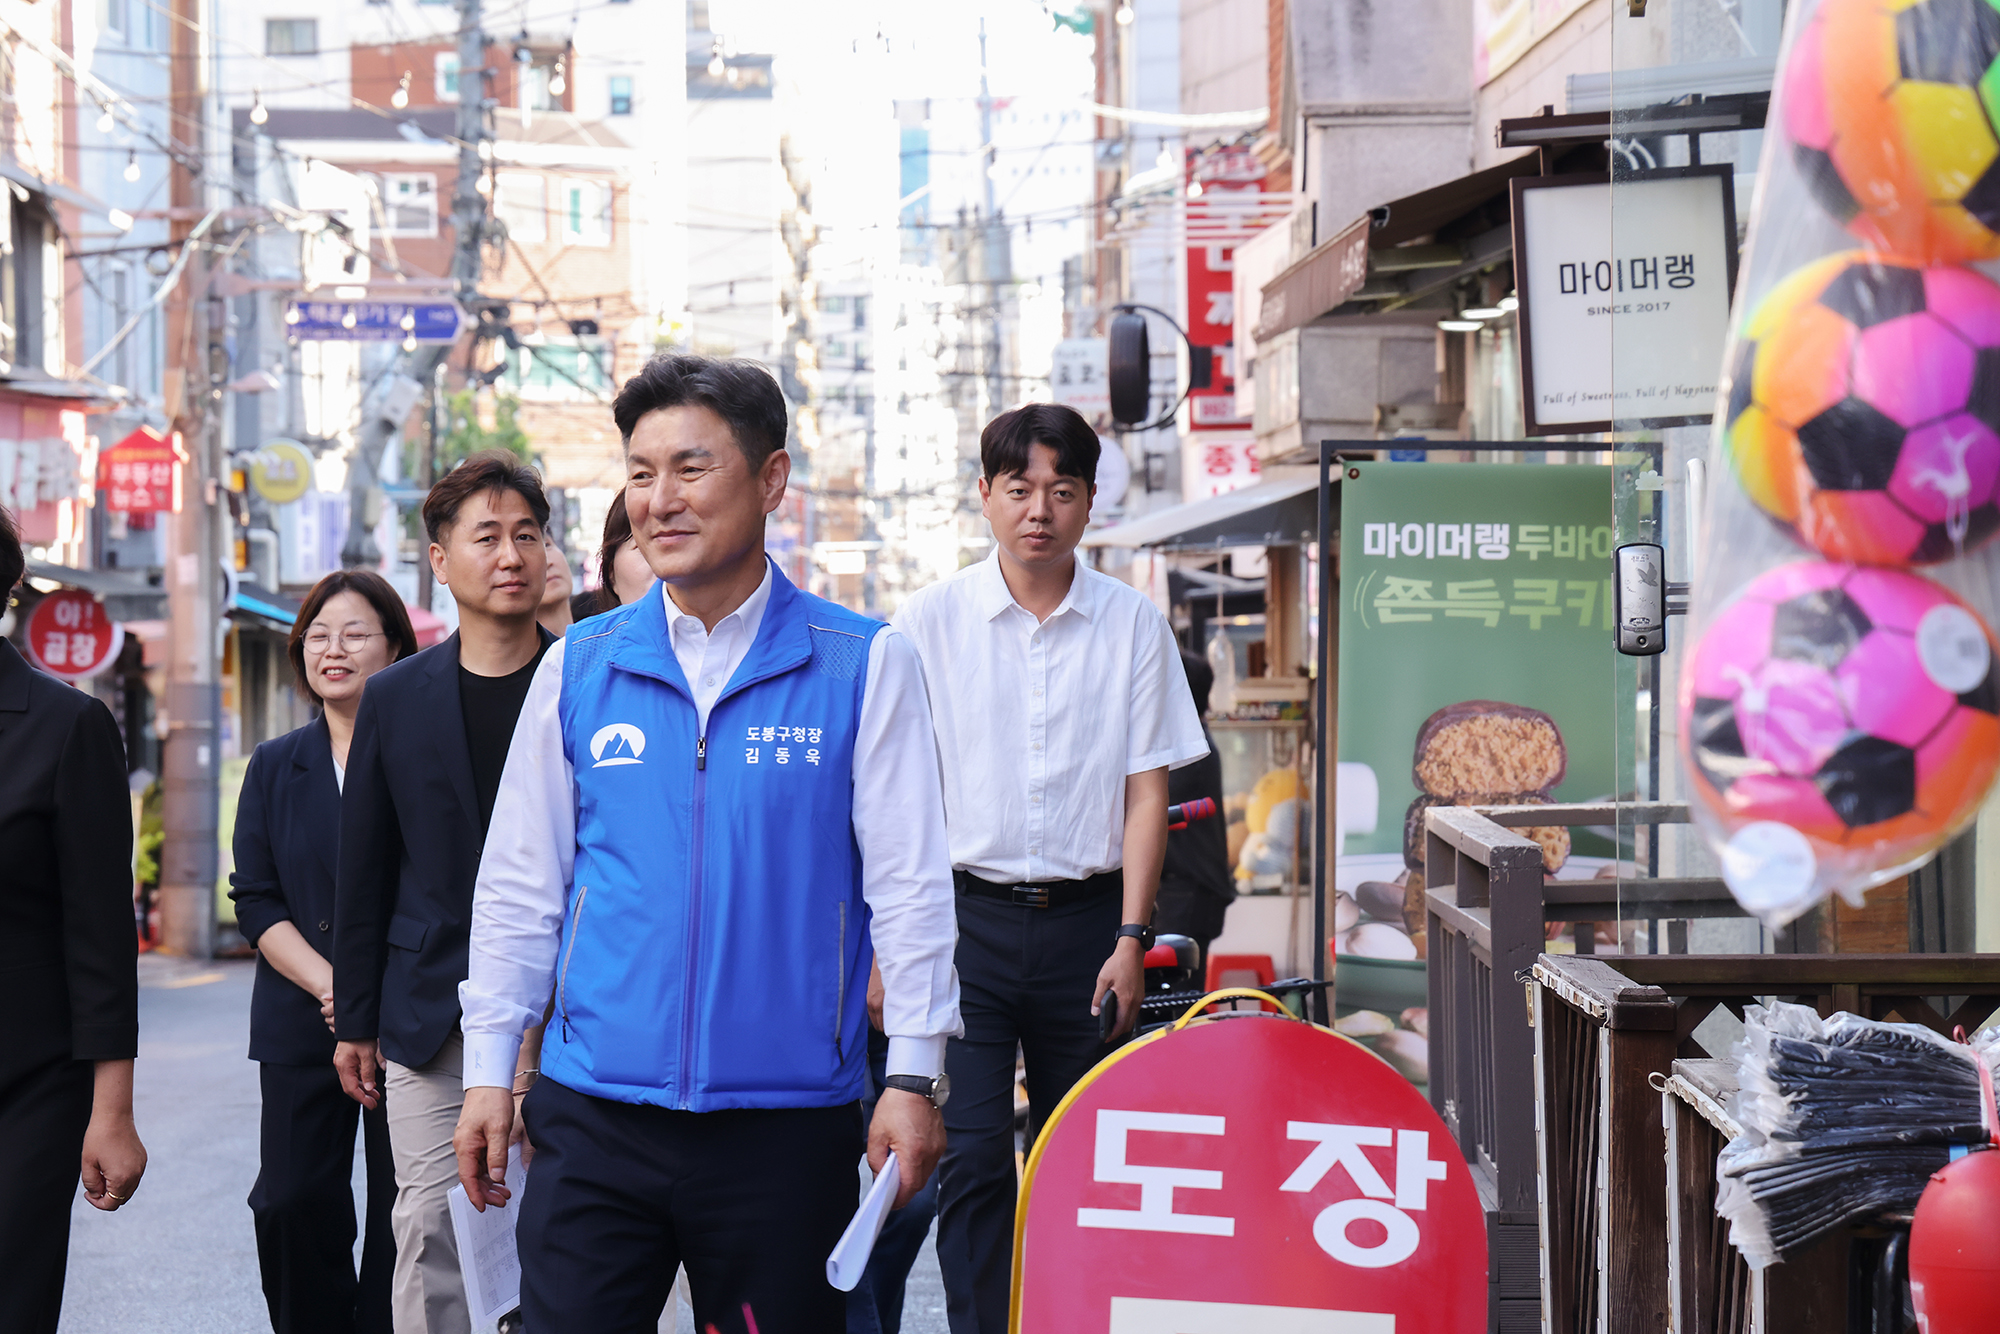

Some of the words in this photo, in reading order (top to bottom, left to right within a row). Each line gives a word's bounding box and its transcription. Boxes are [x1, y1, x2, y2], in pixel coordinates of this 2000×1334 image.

[1559, 253, 1696, 295] 마이머랭
[1587, 304, 1632, 316] SINCE
[1637, 301, 1671, 313] 2017
[1543, 392, 1564, 404] Full
[1567, 391, 1578, 406] of
[1637, 386, 1656, 398] Full
[1660, 385, 1670, 400] of
[111, 462, 171, 487] 부동산
[112, 488, 151, 508] 뉴스
[1363, 522, 1511, 560] 마이머랭
[44, 631, 98, 667] 곱창
[745, 726, 823, 744] 도봉구청장
[1076, 1108, 1448, 1269] 도장
